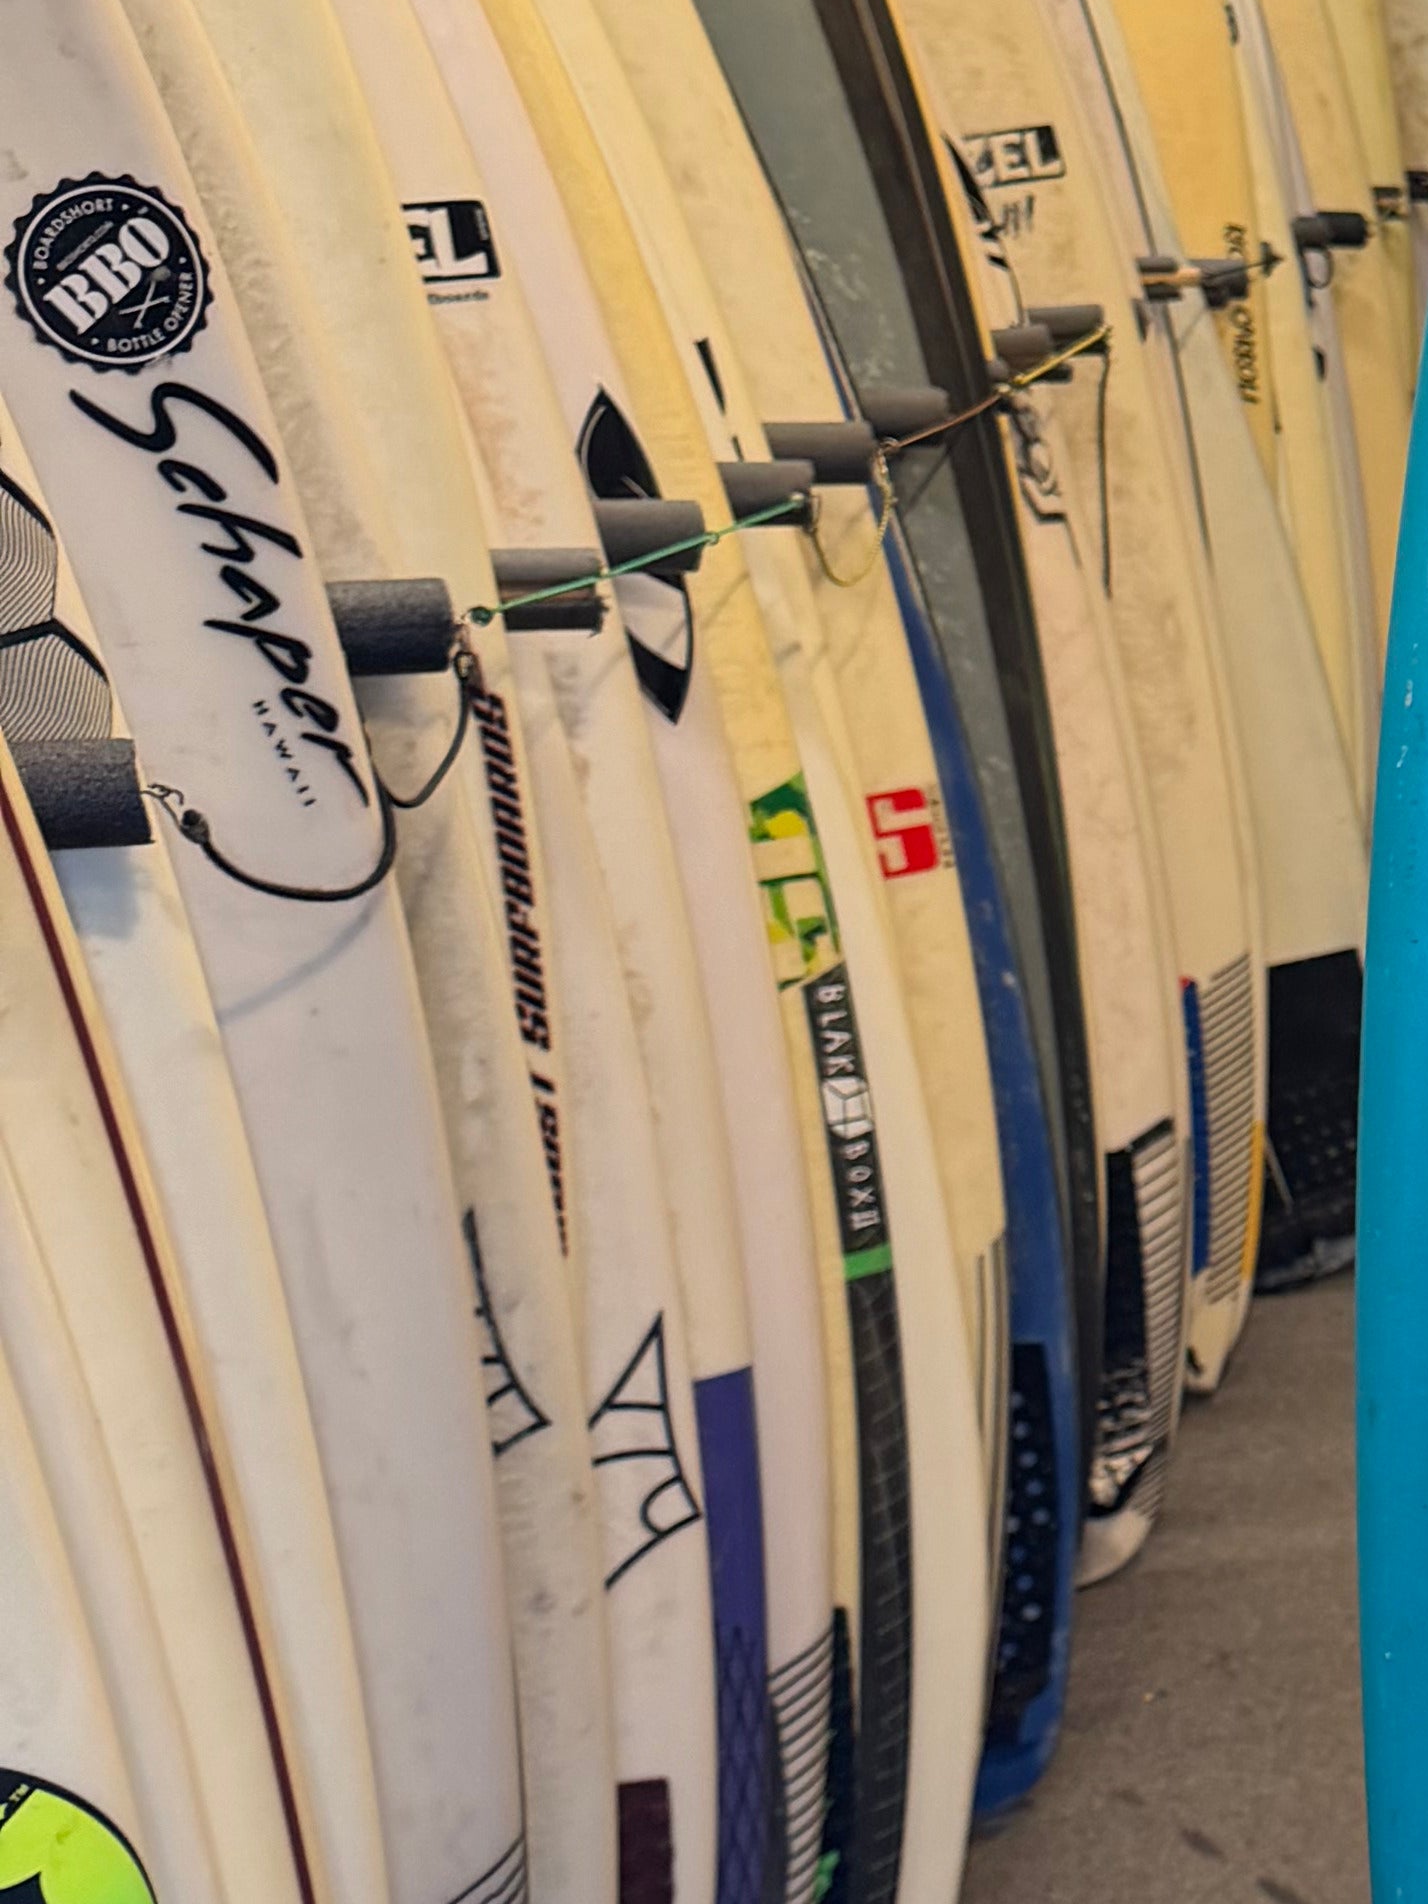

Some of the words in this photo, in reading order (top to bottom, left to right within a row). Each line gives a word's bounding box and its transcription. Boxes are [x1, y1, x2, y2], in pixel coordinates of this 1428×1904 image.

[33, 198, 114, 270] BOARDSHORT
[43, 217, 170, 336] BBO
[107, 327, 166, 353] BOTTLE
[164, 271, 195, 333] OPENER
[69, 381, 371, 808] Schaper
[254, 699, 316, 808] HAWAII
[474, 692, 553, 1053] SURFBOARDS
[817, 982, 855, 1077] BLAK
